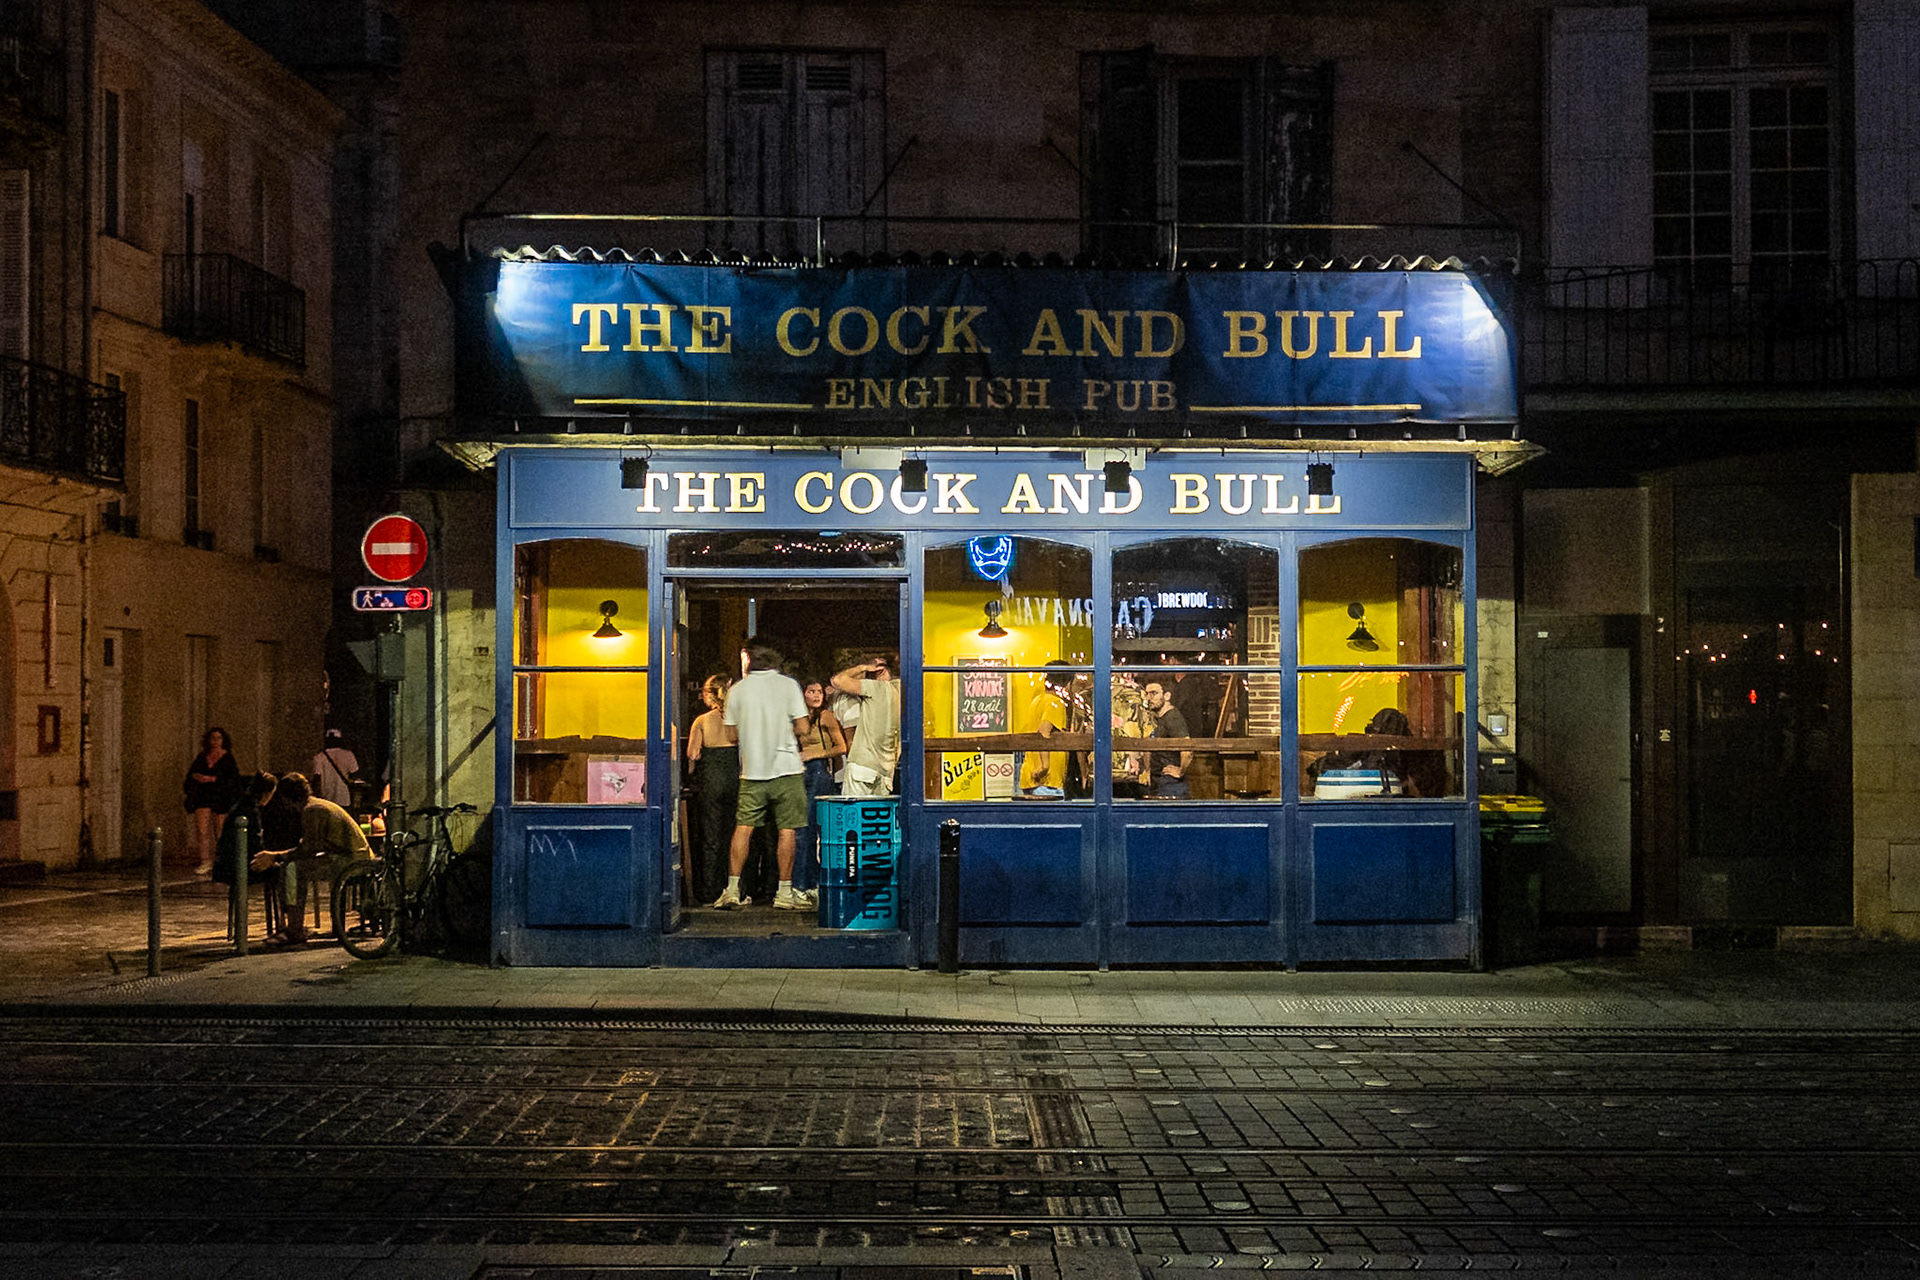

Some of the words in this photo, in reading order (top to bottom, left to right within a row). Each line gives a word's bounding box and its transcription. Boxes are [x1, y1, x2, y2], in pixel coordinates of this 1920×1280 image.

[572, 303, 732, 355] THE
[775, 304, 991, 357] COCK
[1022, 308, 1186, 358] AND
[1223, 309, 1422, 359] BULL
[825, 377, 1050, 411] ENGLISH
[1083, 379, 1177, 412] PUB
[635, 472, 765, 514] THE
[794, 471, 979, 514] COCK
[1001, 472, 1143, 515] AND
[962, 699, 977, 713] 28
[943, 753, 982, 787] Suze
[861, 806, 892, 919] BREWDOG
